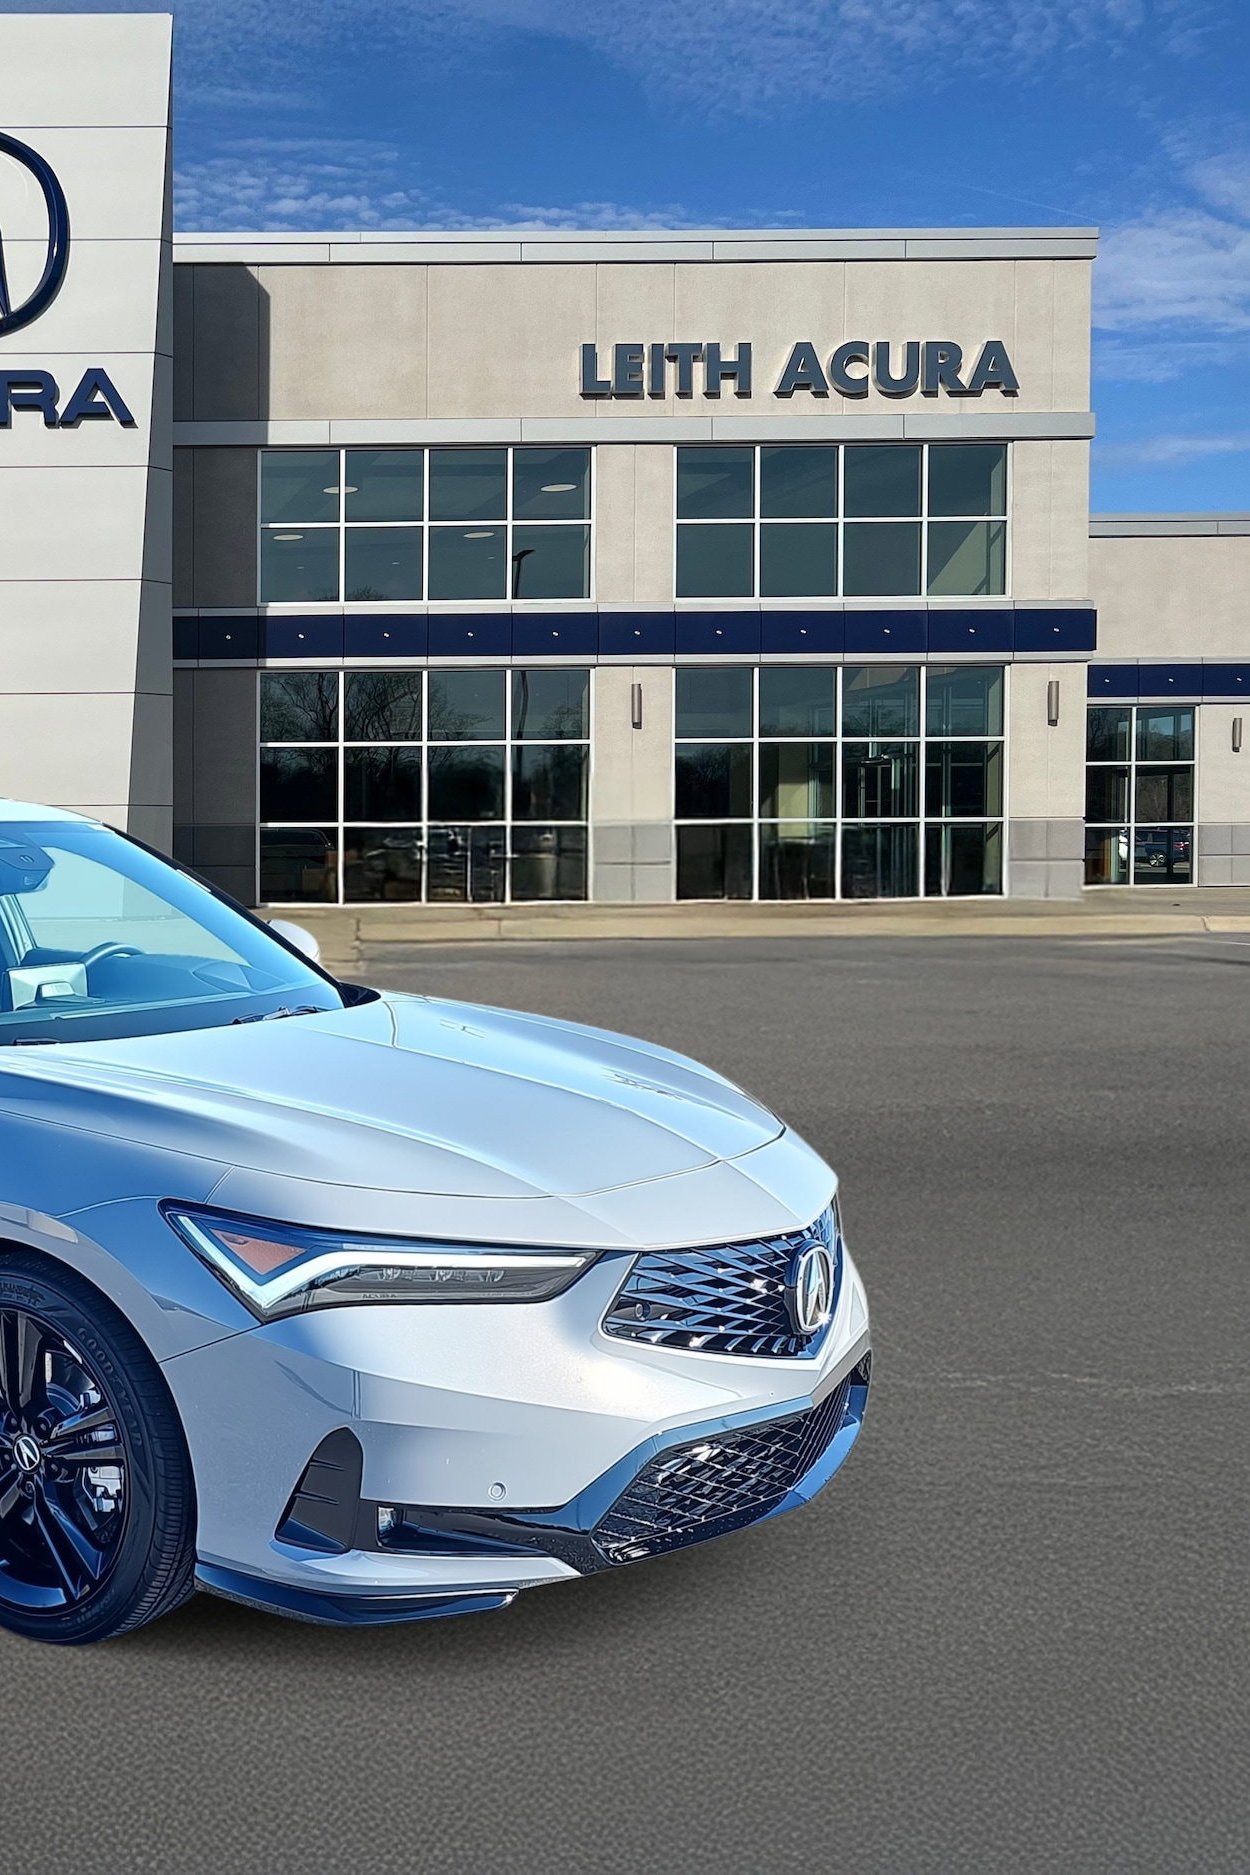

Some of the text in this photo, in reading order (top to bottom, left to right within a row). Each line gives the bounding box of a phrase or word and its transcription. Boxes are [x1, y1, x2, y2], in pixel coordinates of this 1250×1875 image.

[579, 340, 1019, 399] LEITH ACURA
[77, 1327, 142, 1447] GOODYEAR
